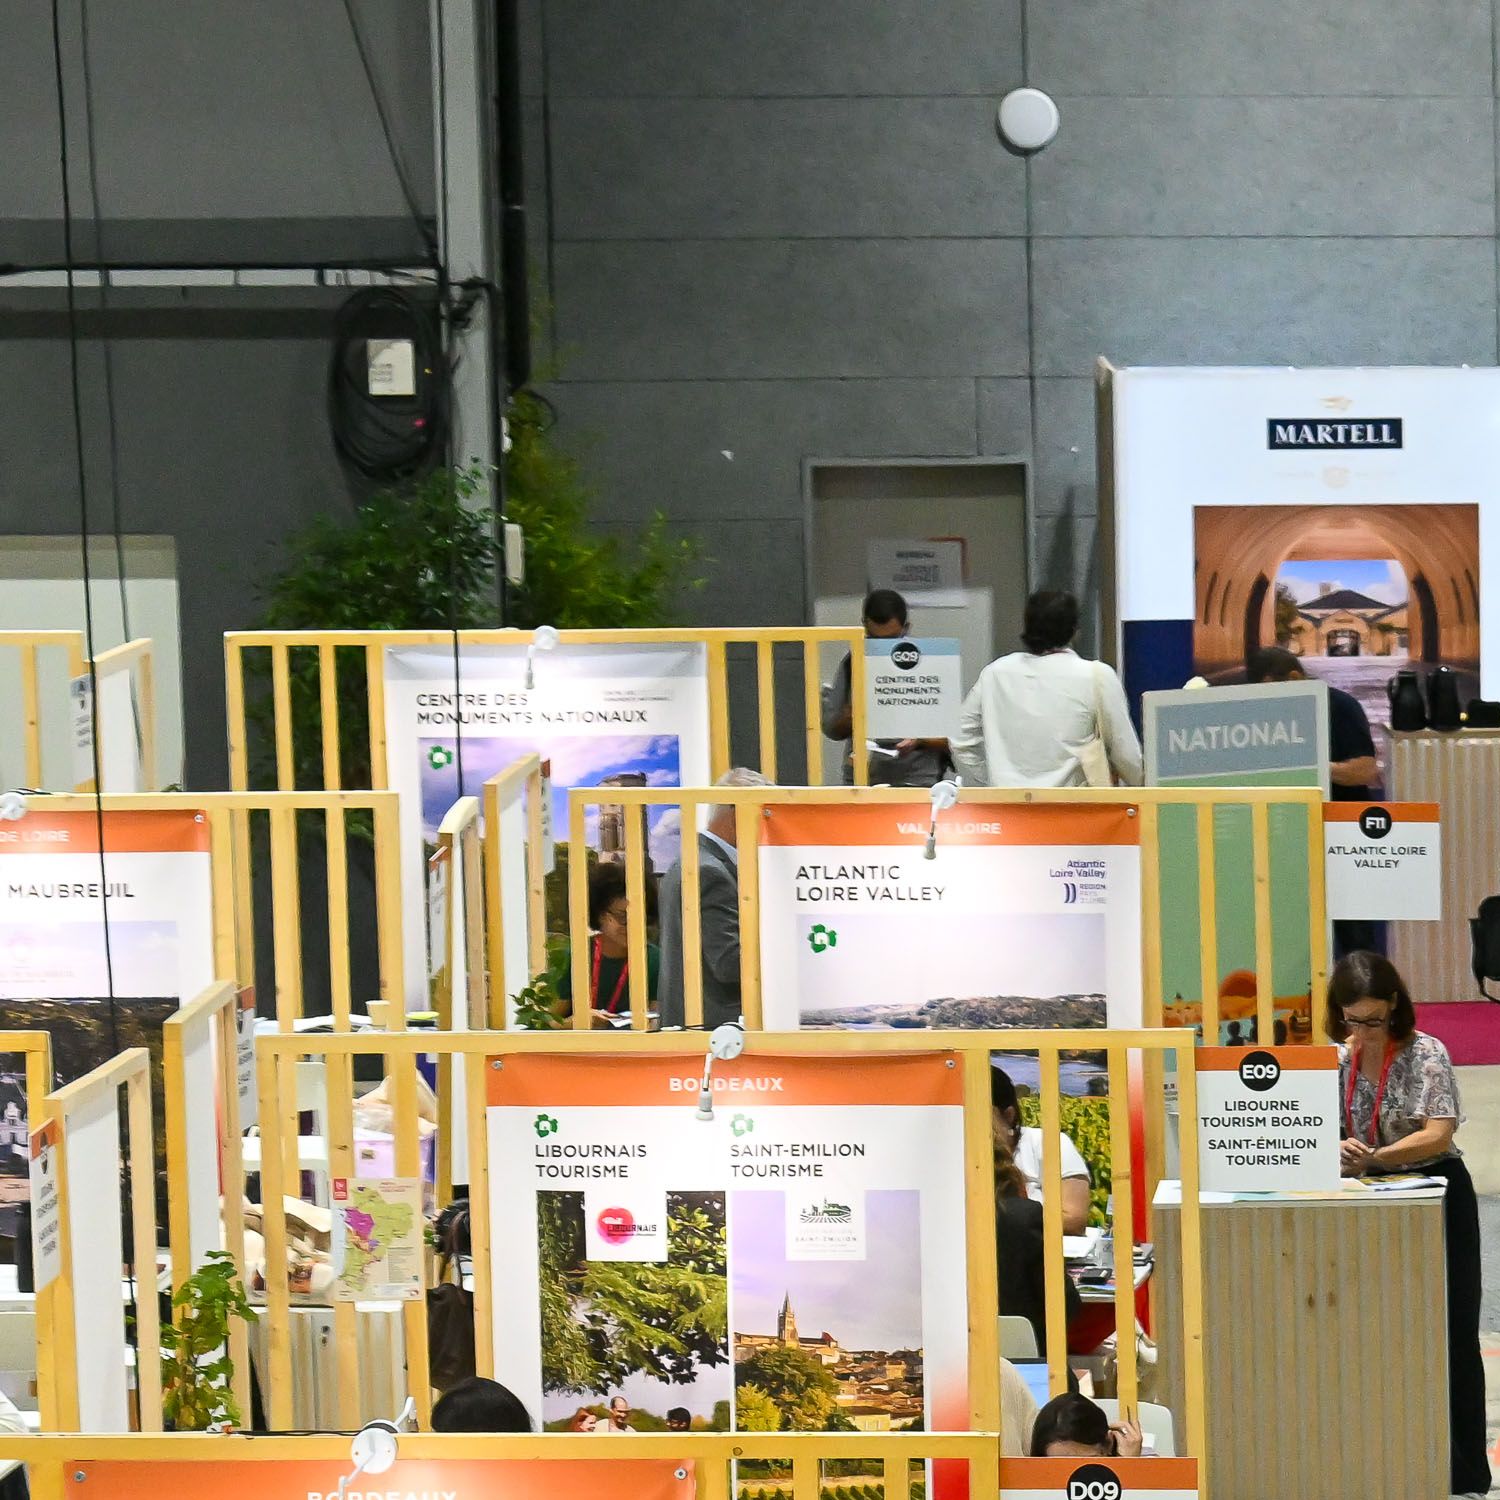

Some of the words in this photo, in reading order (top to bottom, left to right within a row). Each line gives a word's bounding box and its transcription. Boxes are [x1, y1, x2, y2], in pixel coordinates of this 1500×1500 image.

[1274, 424, 1397, 445] MARTELL
[876, 675, 916, 684] CENTRE
[919, 675, 939, 684] DES
[874, 686, 940, 695] MONUMENTS
[416, 694, 487, 706] CENTRE
[496, 694, 528, 706] DES
[877, 697, 939, 706] NATIONAUX
[418, 712, 533, 724] MONUMENTS
[541, 710, 648, 723] NATIONAUX
[1169, 719, 1305, 752] NATIONAL
[896, 822, 927, 834] VAL
[958, 822, 1001, 834] LOIRE
[22, 830, 70, 842] LOIRE
[1328, 846, 1387, 856] ATLANTIC
[1391, 846, 1427, 856] LOIRE
[1067, 860, 1106, 868] Atlantic
[1355, 859, 1400, 869] VALLEY
[796, 865, 901, 880] ATLANTIC
[1049, 869, 1073, 878] Loire
[1075, 869, 1106, 879] Valley
[8, 883, 135, 899] MAUBREUIL
[796, 886, 858, 901] LOIRE
[868, 886, 946, 901] VALLEY
[1243, 1064, 1278, 1079] E09
[669, 1077, 783, 1091] BODEAUX
[1225, 1100, 1300, 1111] LIBOURNE
[1201, 1117, 1267, 1127] TOURISM
[1271, 1116, 1323, 1127] BOARD
[1208, 1136, 1317, 1149] SAINT-ÉMILION
[535, 1145, 647, 1158] LIBOURNAIS
[730, 1144, 865, 1157] SAINT-EMILION
[1226, 1155, 1301, 1165] TOURISME
[536, 1165, 629, 1178] TOURISME
[731, 1165, 823, 1177] TOURISME
[1070, 1481, 1119, 1500] D09
